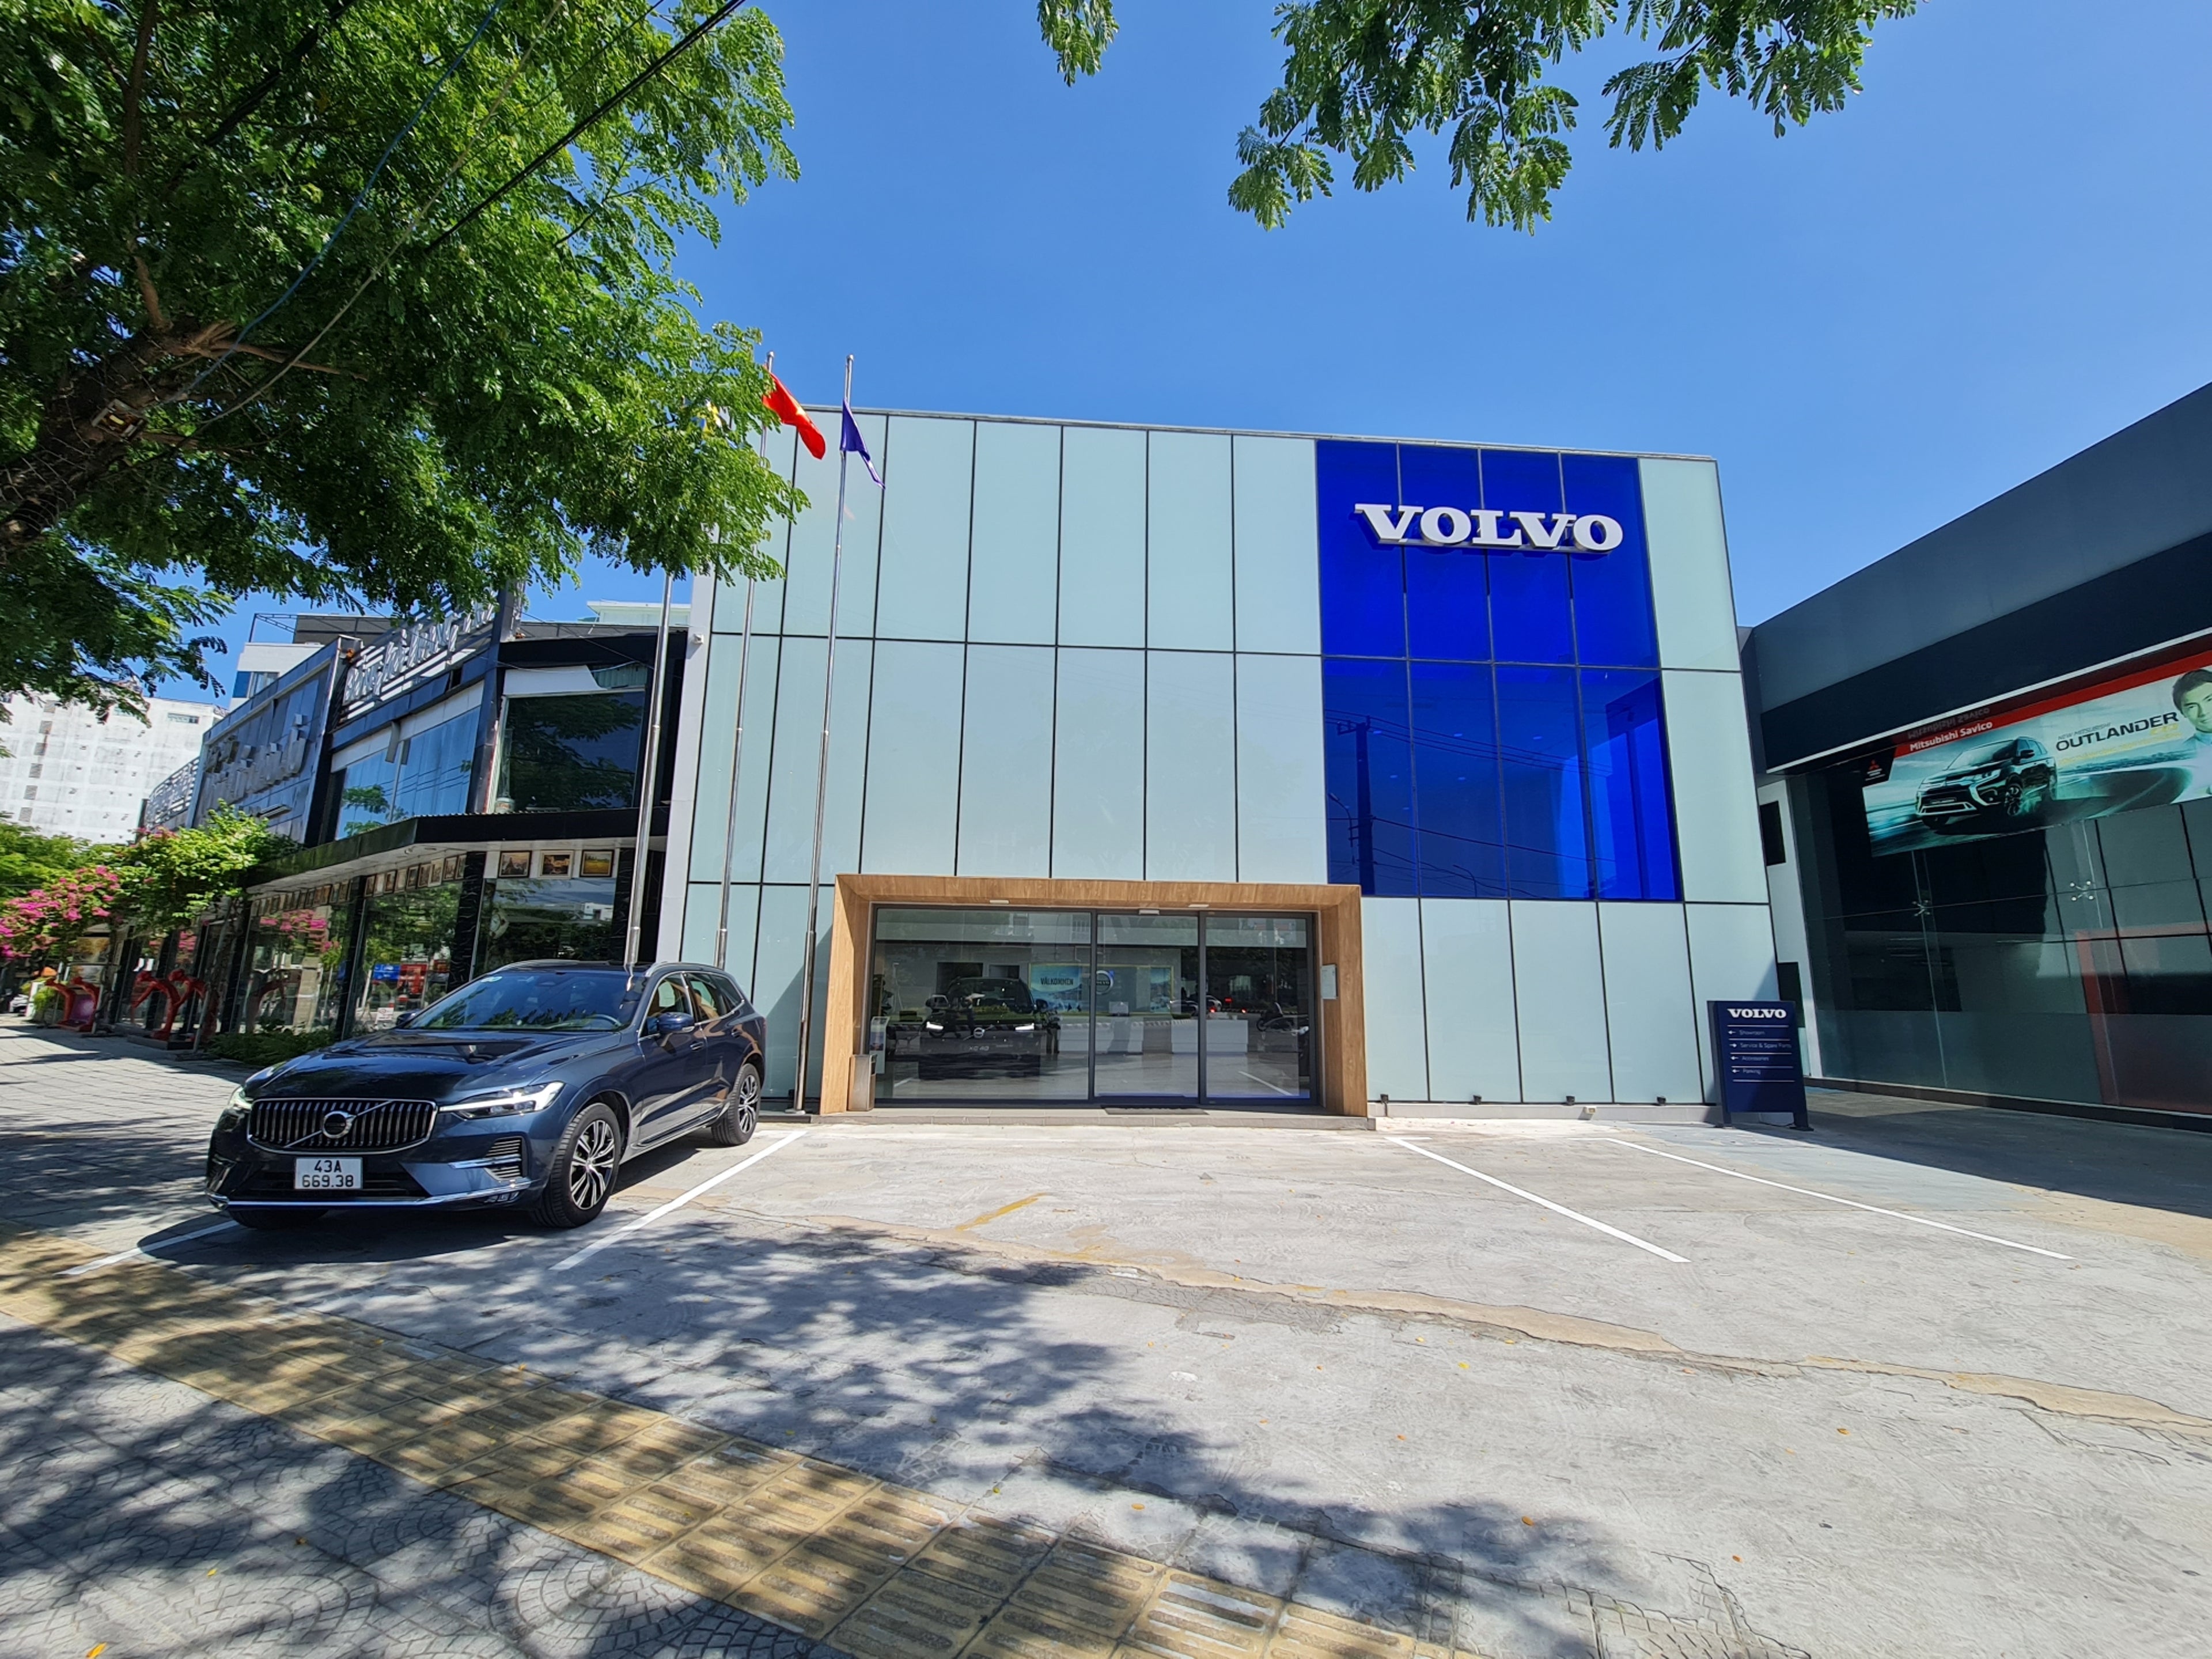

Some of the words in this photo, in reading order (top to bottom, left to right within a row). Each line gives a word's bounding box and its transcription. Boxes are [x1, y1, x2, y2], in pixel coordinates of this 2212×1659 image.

[1355, 503, 1623, 551] VOLVO
[1910, 730, 1958, 751] Mitsubishi
[1960, 721, 1993, 737] Savico
[2056, 712, 2179, 751] OUTLANDER
[1727, 1008, 1787, 1018] VOLVO
[314, 1160, 342, 1173] 43A
[302, 1175, 354, 1187] 669.38
